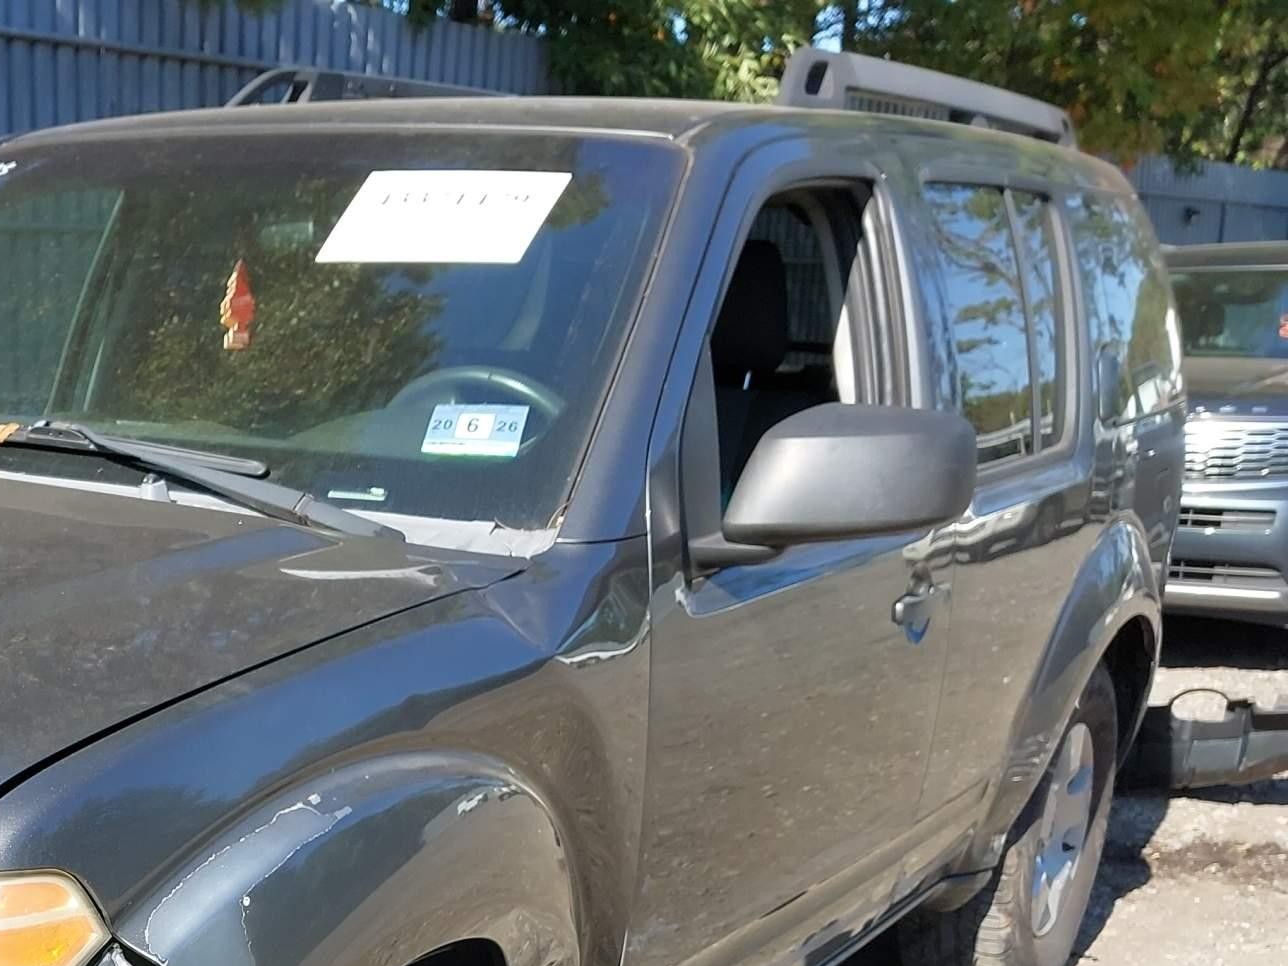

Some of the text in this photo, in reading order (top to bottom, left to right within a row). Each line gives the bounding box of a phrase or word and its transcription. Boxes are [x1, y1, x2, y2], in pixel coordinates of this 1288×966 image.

[431, 417, 518, 433] 20 6 26
